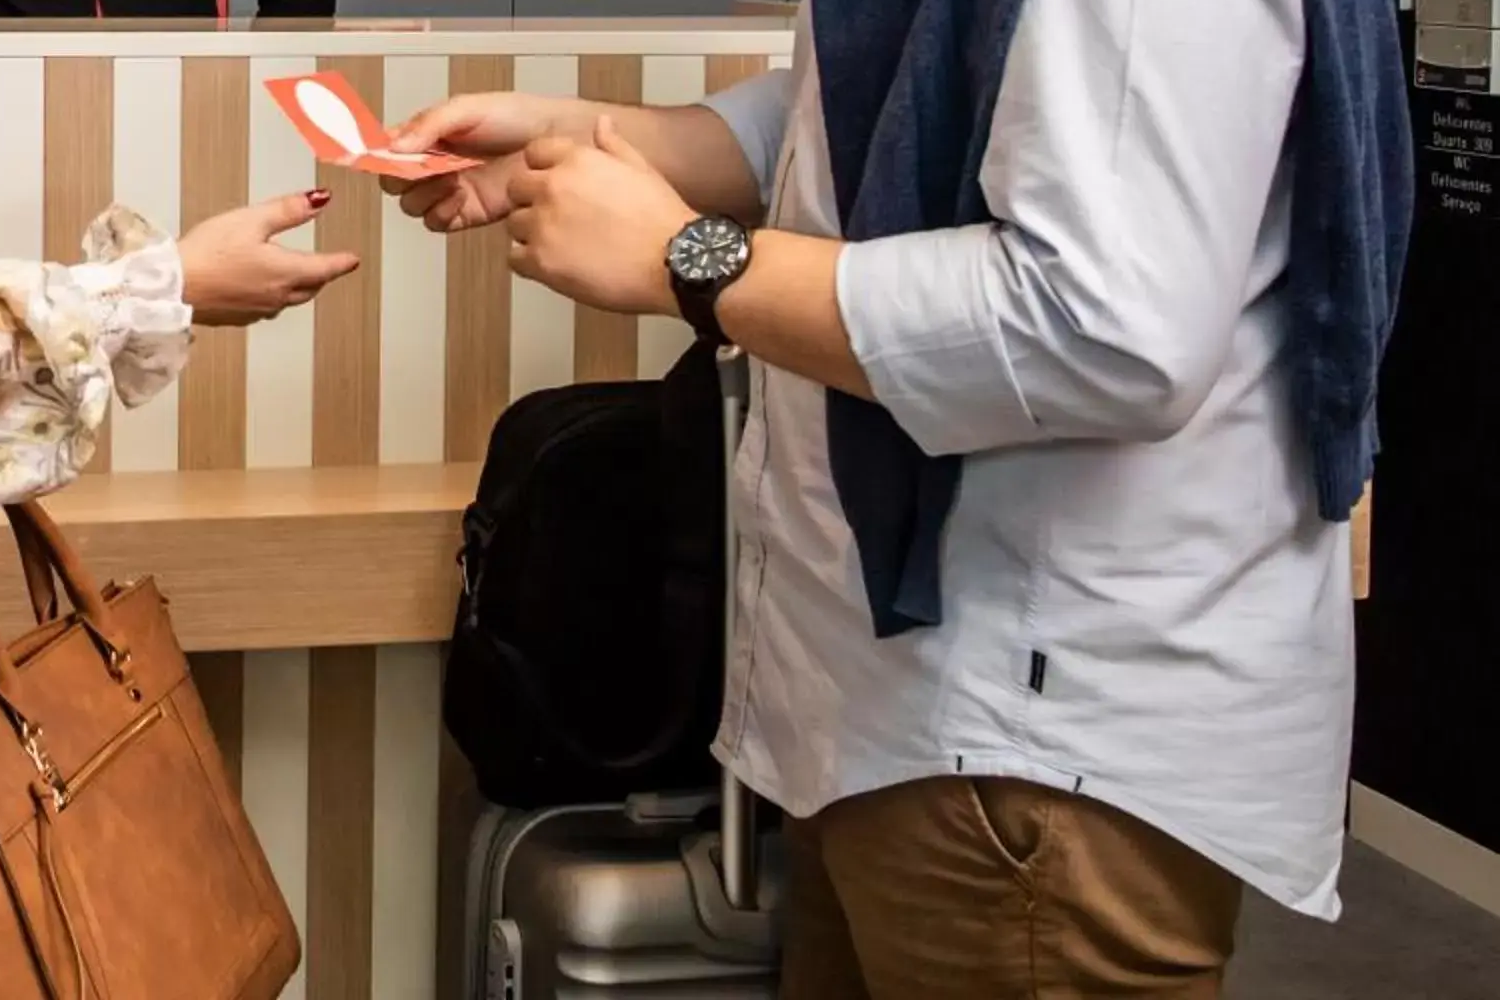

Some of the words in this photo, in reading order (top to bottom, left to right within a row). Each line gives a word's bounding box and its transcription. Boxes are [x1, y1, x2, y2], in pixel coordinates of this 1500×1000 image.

[1432, 110, 1494, 133] Deficientes
[1453, 156, 1472, 171] WC
[1430, 171, 1493, 194] Deficientes
[1440, 193, 1482, 215] Serviço
